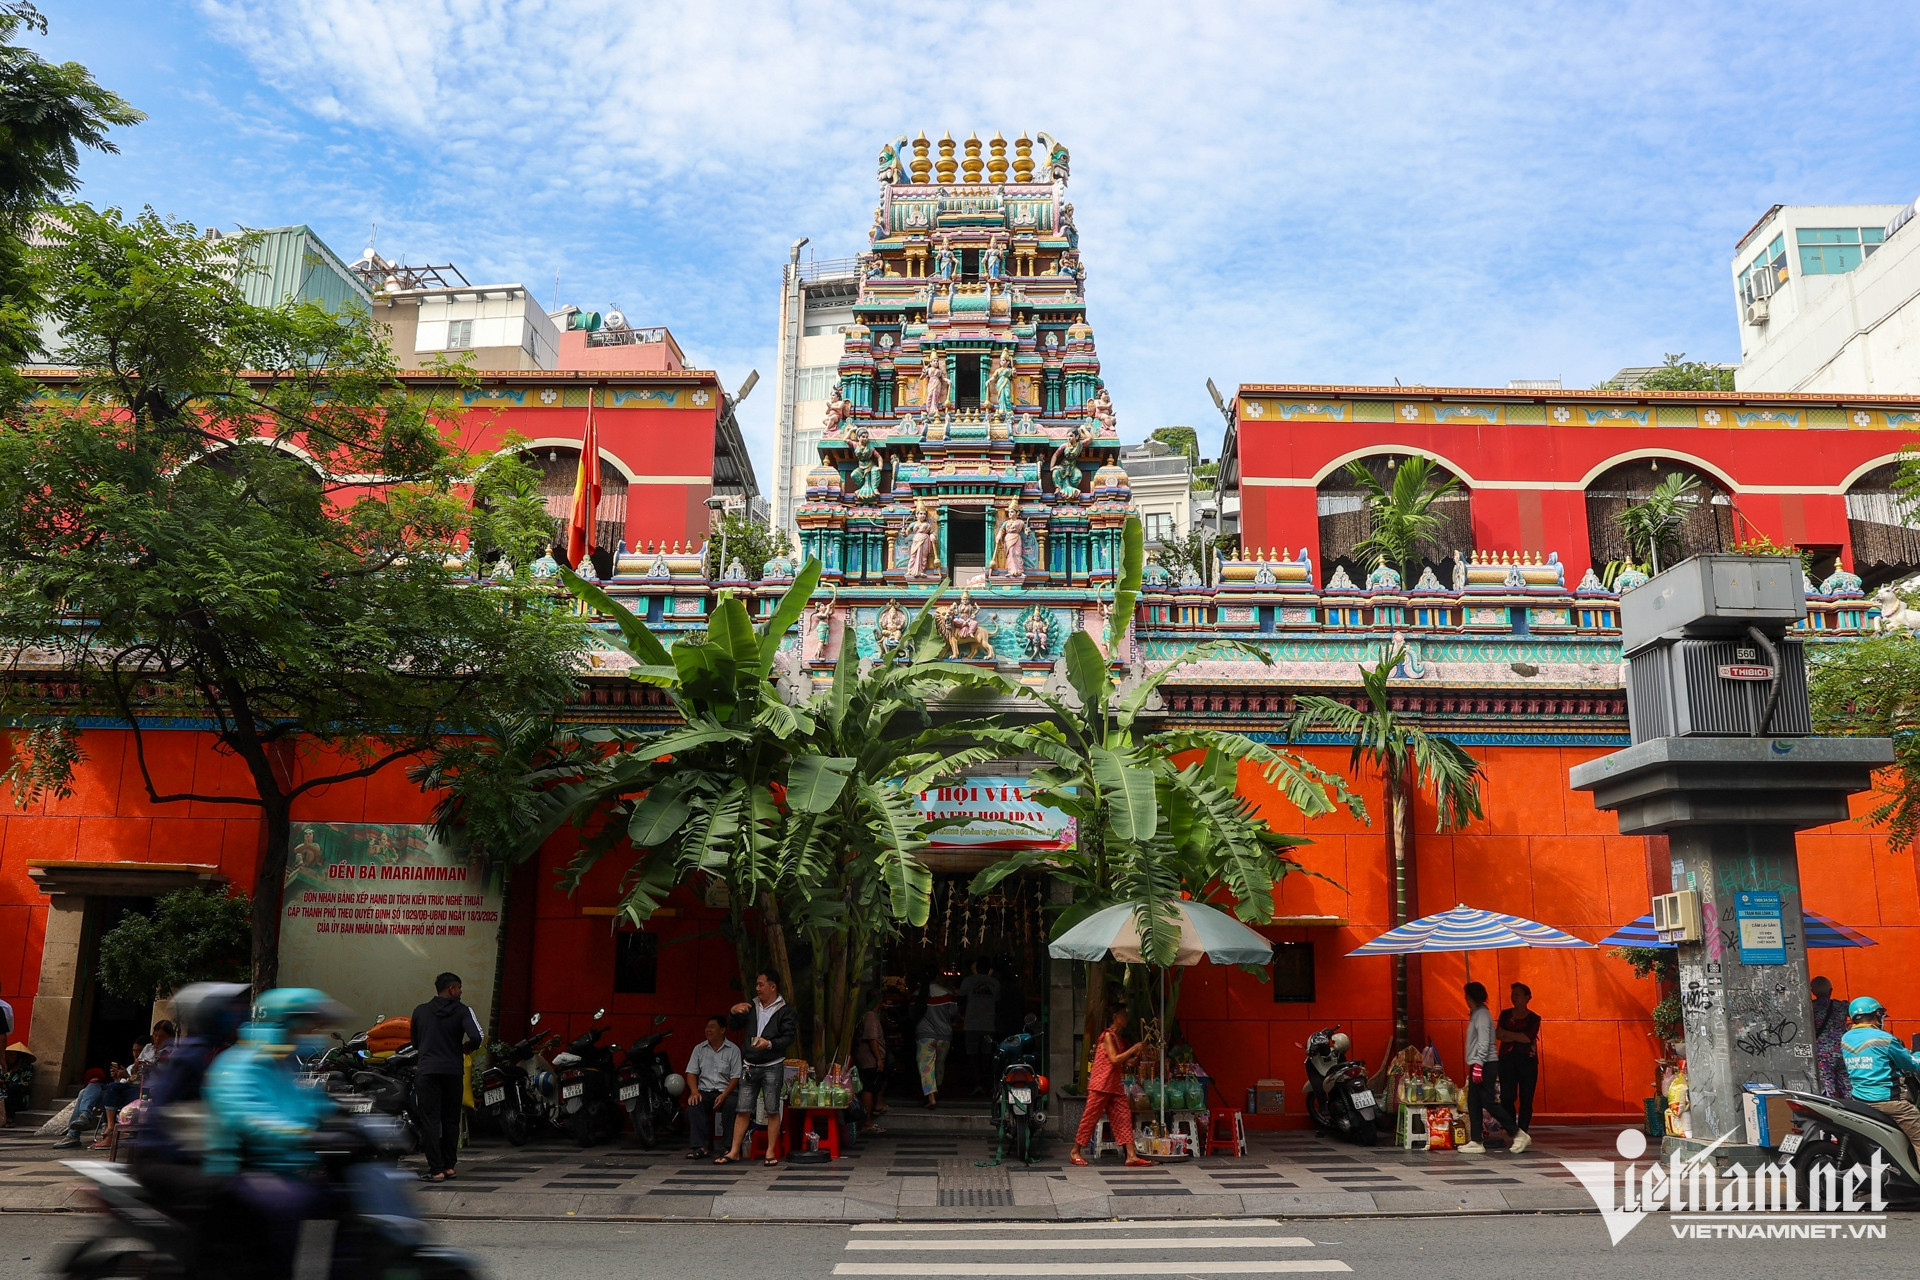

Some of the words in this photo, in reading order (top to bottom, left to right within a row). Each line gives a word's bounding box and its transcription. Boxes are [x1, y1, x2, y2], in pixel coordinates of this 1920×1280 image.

[1738, 650, 1754, 658] 560
[938, 785, 978, 805] HỘI
[984, 784, 1023, 802] VÍA
[979, 812, 1045, 821] HOLIDAY
[329, 860, 355, 879] ĐỀN
[359, 862, 376, 879] BÀ
[381, 866, 466, 881] MARIAMMAN
[389, 895, 395, 904] DI
[397, 893, 410, 904] TÍCH
[428, 893, 444, 905] TRÚC
[338, 908, 353, 918] THEO
[341, 923, 354, 933] BAN
[436, 923, 446, 936] CHÍ
[448, 926, 465, 936] MINH
